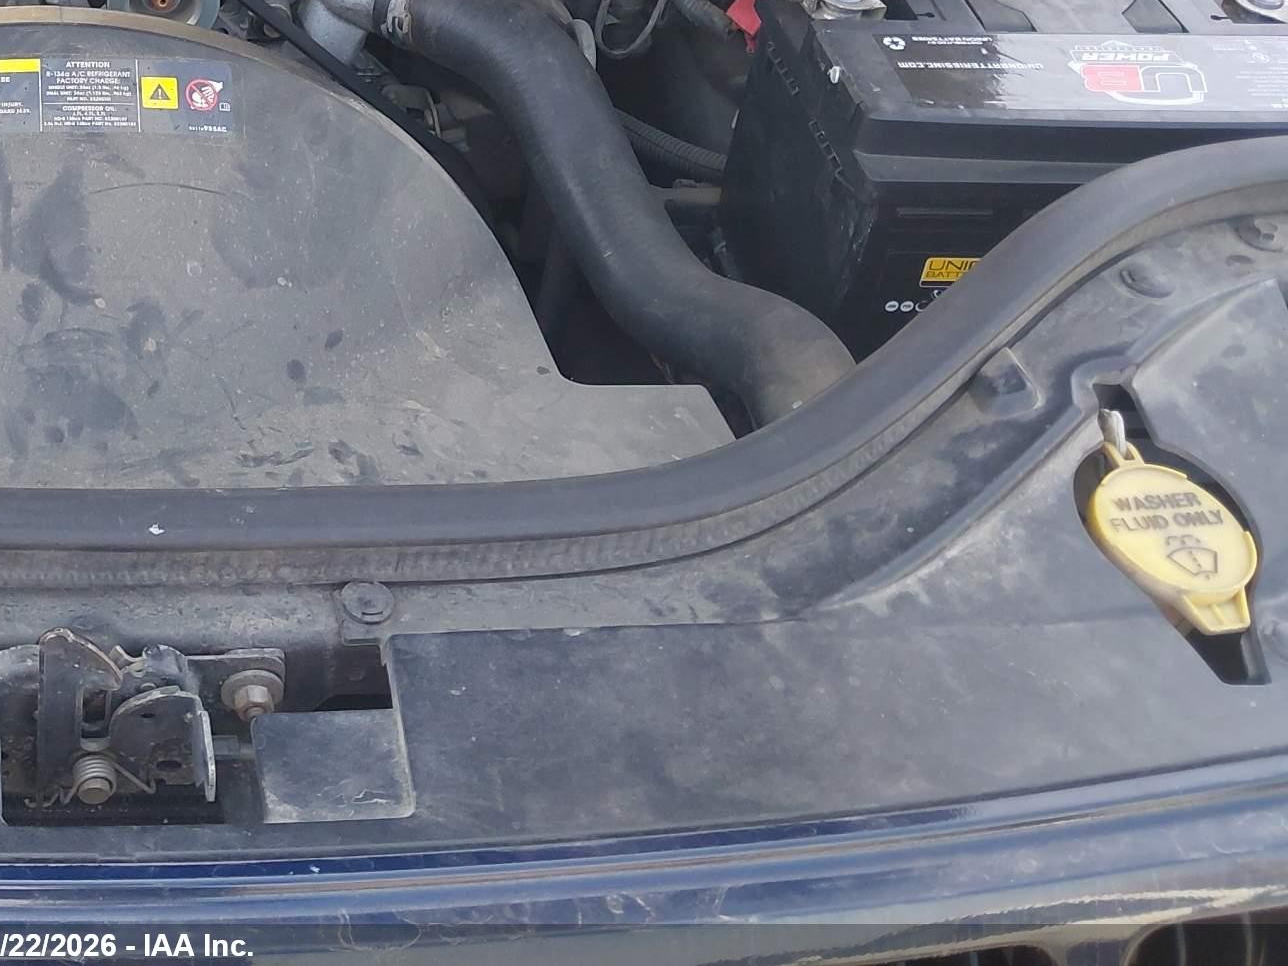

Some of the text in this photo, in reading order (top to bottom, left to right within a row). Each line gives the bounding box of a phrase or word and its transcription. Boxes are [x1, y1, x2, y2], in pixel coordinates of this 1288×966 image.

[1081, 52, 1170, 62] POWER
[87, 70, 131, 78] REFRIGERANT
[1113, 492, 1202, 511] WASHER
[1110, 510, 1224, 531] FLUID ONLY
